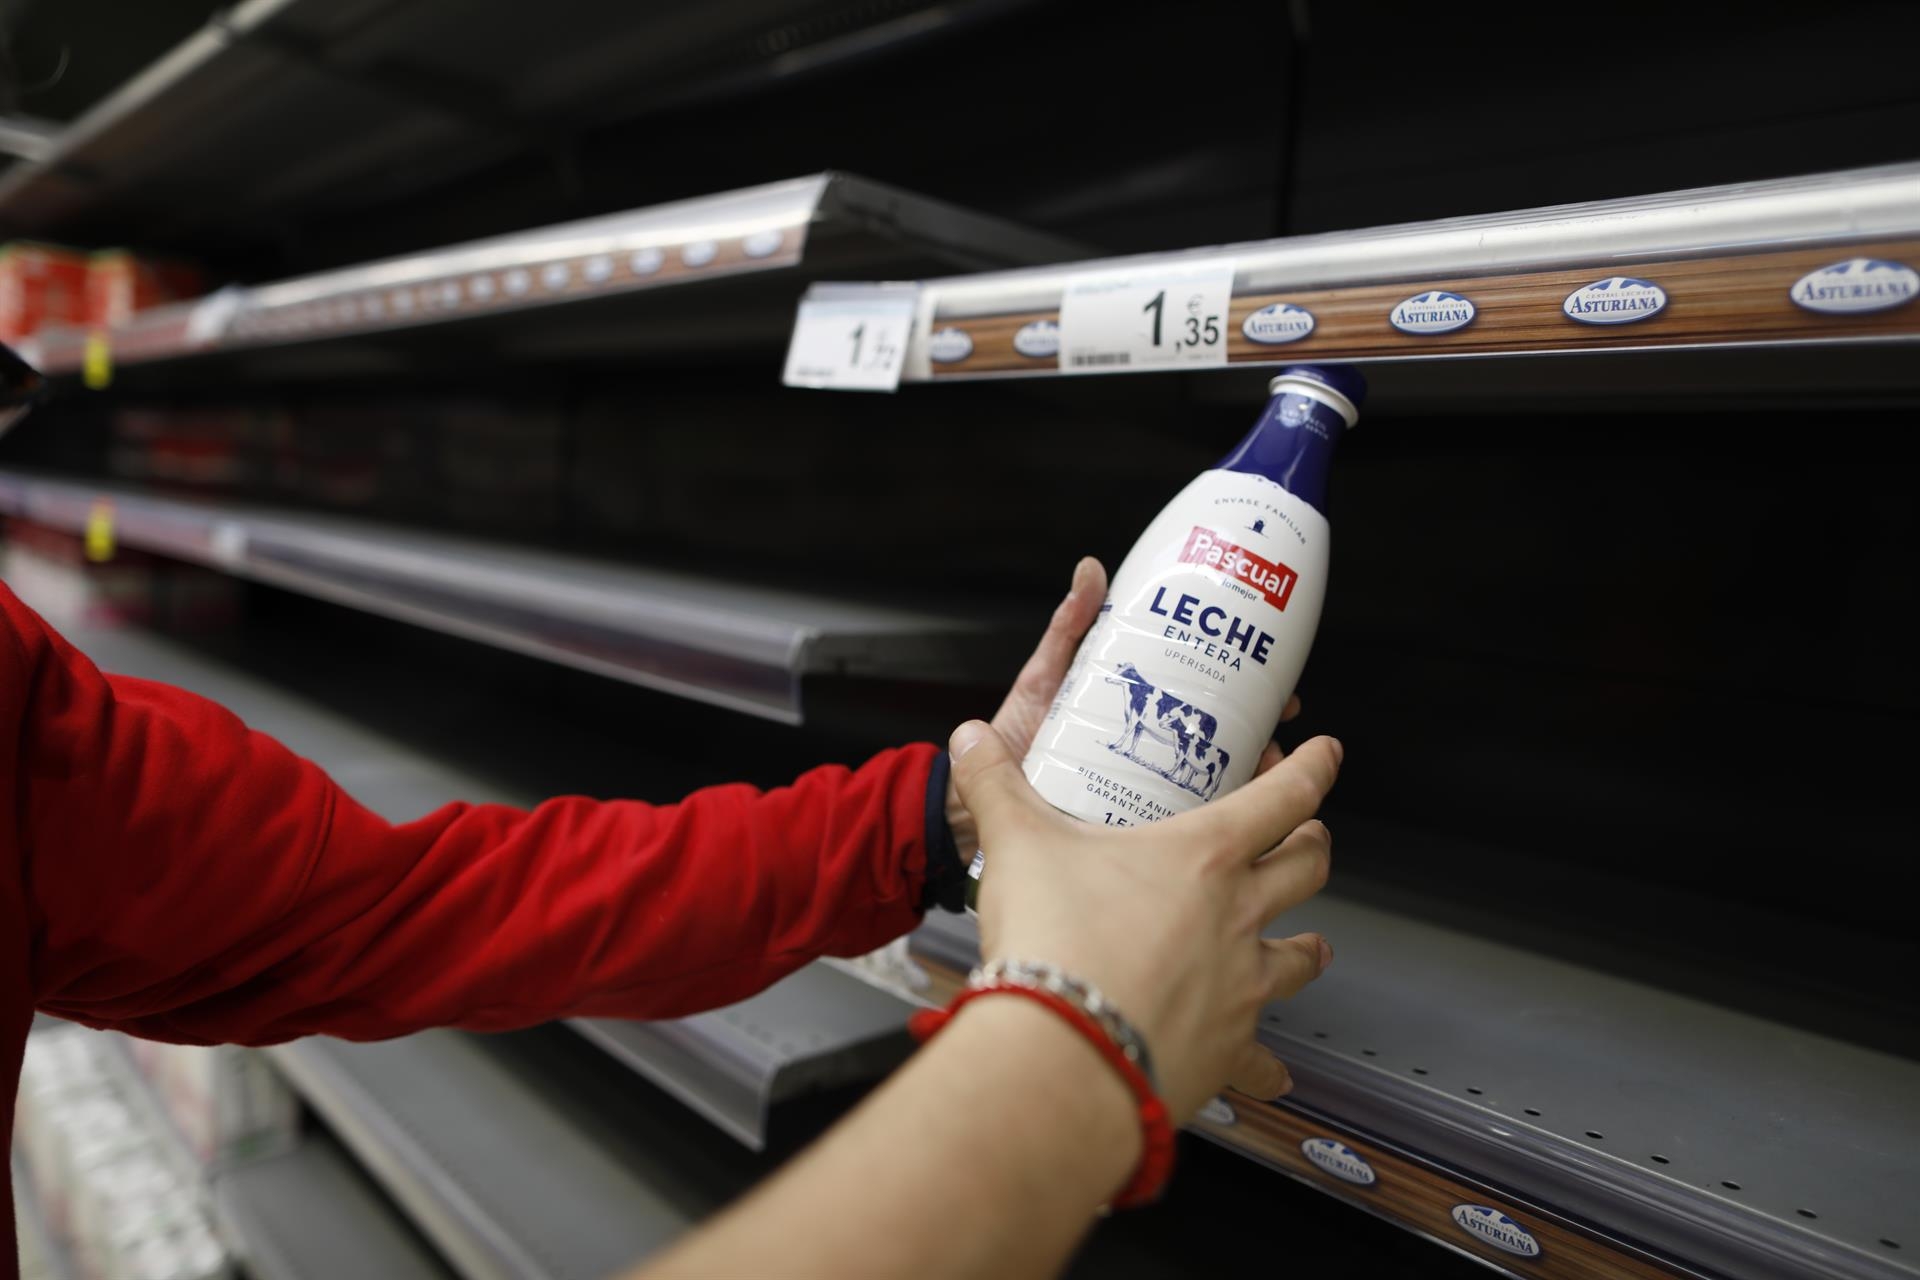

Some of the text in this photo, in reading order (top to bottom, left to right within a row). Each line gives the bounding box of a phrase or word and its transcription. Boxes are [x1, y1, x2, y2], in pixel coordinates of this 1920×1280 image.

[1144, 290, 1219, 353] 1,35
[1396, 308, 1469, 324] ASTURIANA
[1570, 295, 1659, 314] ASTURIANA
[1249, 319, 1309, 334] ASTURIANA
[1214, 497, 1307, 545] ENVASE FAMILIAR
[1189, 533, 1291, 598] Pascual
[1231, 582, 1258, 601] mejor
[1150, 586, 1275, 666] LECHE
[1164, 625, 1241, 671] ENTERA
[1165, 648, 1226, 684] UPERISADA
[1078, 766, 1142, 803] BIENESTAR
[1086, 783, 1162, 822] GARANTIZA
[1459, 1210, 1534, 1254] ASTURIANA
